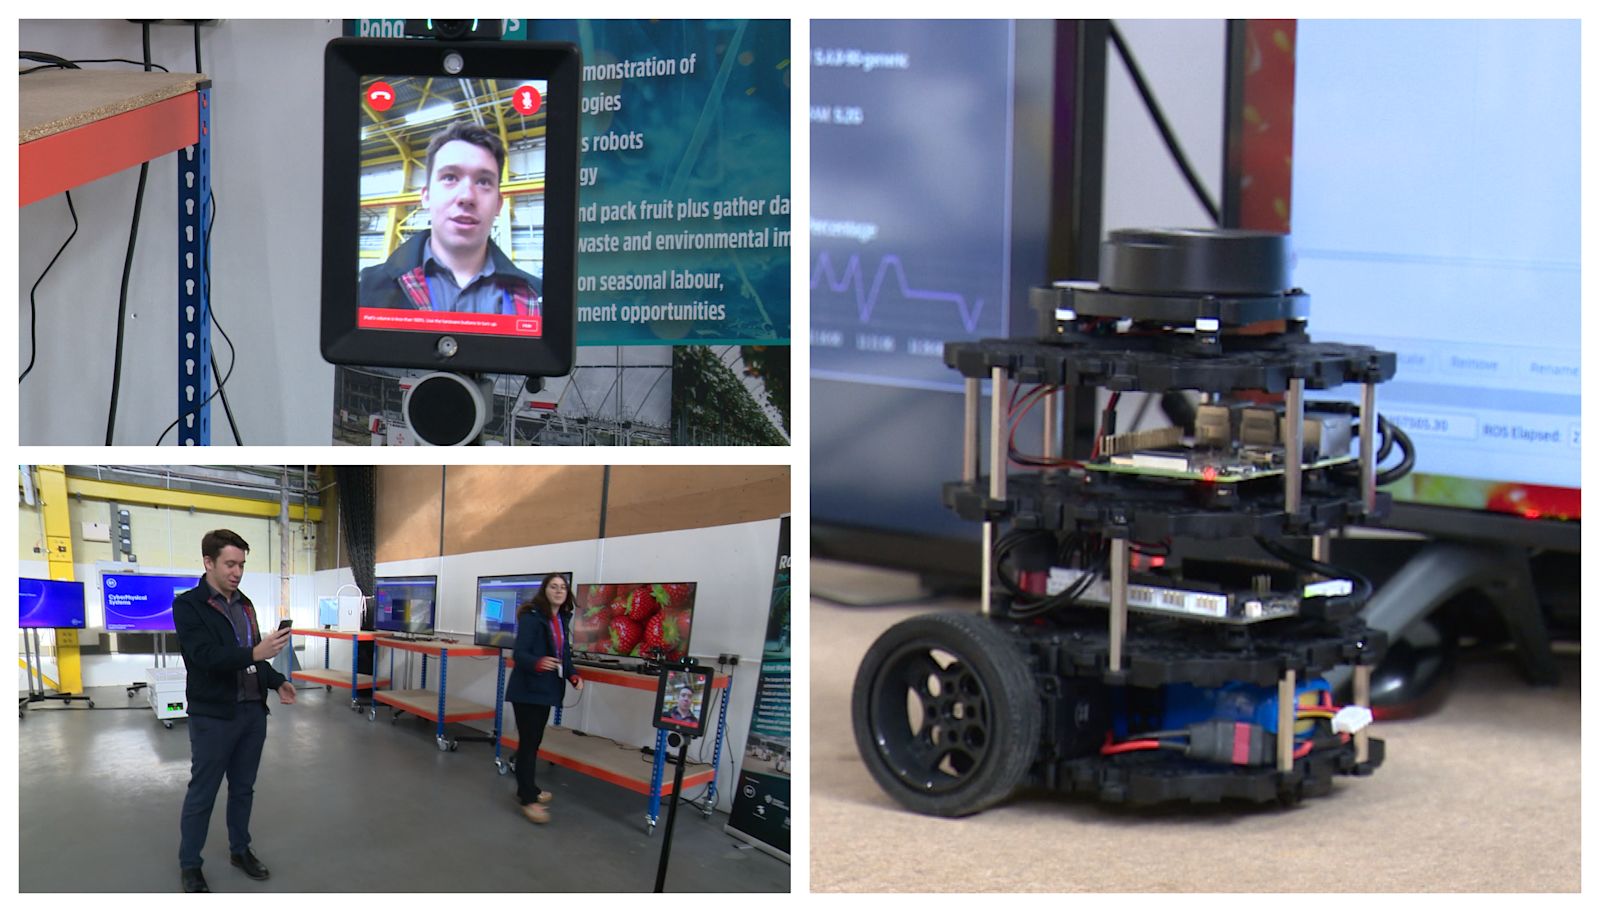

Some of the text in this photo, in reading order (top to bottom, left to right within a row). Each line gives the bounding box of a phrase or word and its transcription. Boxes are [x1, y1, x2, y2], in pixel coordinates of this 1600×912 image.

[582, 53, 696, 81] monstration of
[581, 93, 622, 115] ogies
[581, 131, 643, 152] s robots
[580, 167, 598, 185] gy
[579, 195, 790, 224] nd pack fruit plus gather da
[578, 234, 619, 253] waste
[623, 231, 652, 251] and
[656, 228, 769, 250] environmental
[578, 269, 724, 291] on seasonal labour,
[578, 301, 726, 323] ment opportunities
